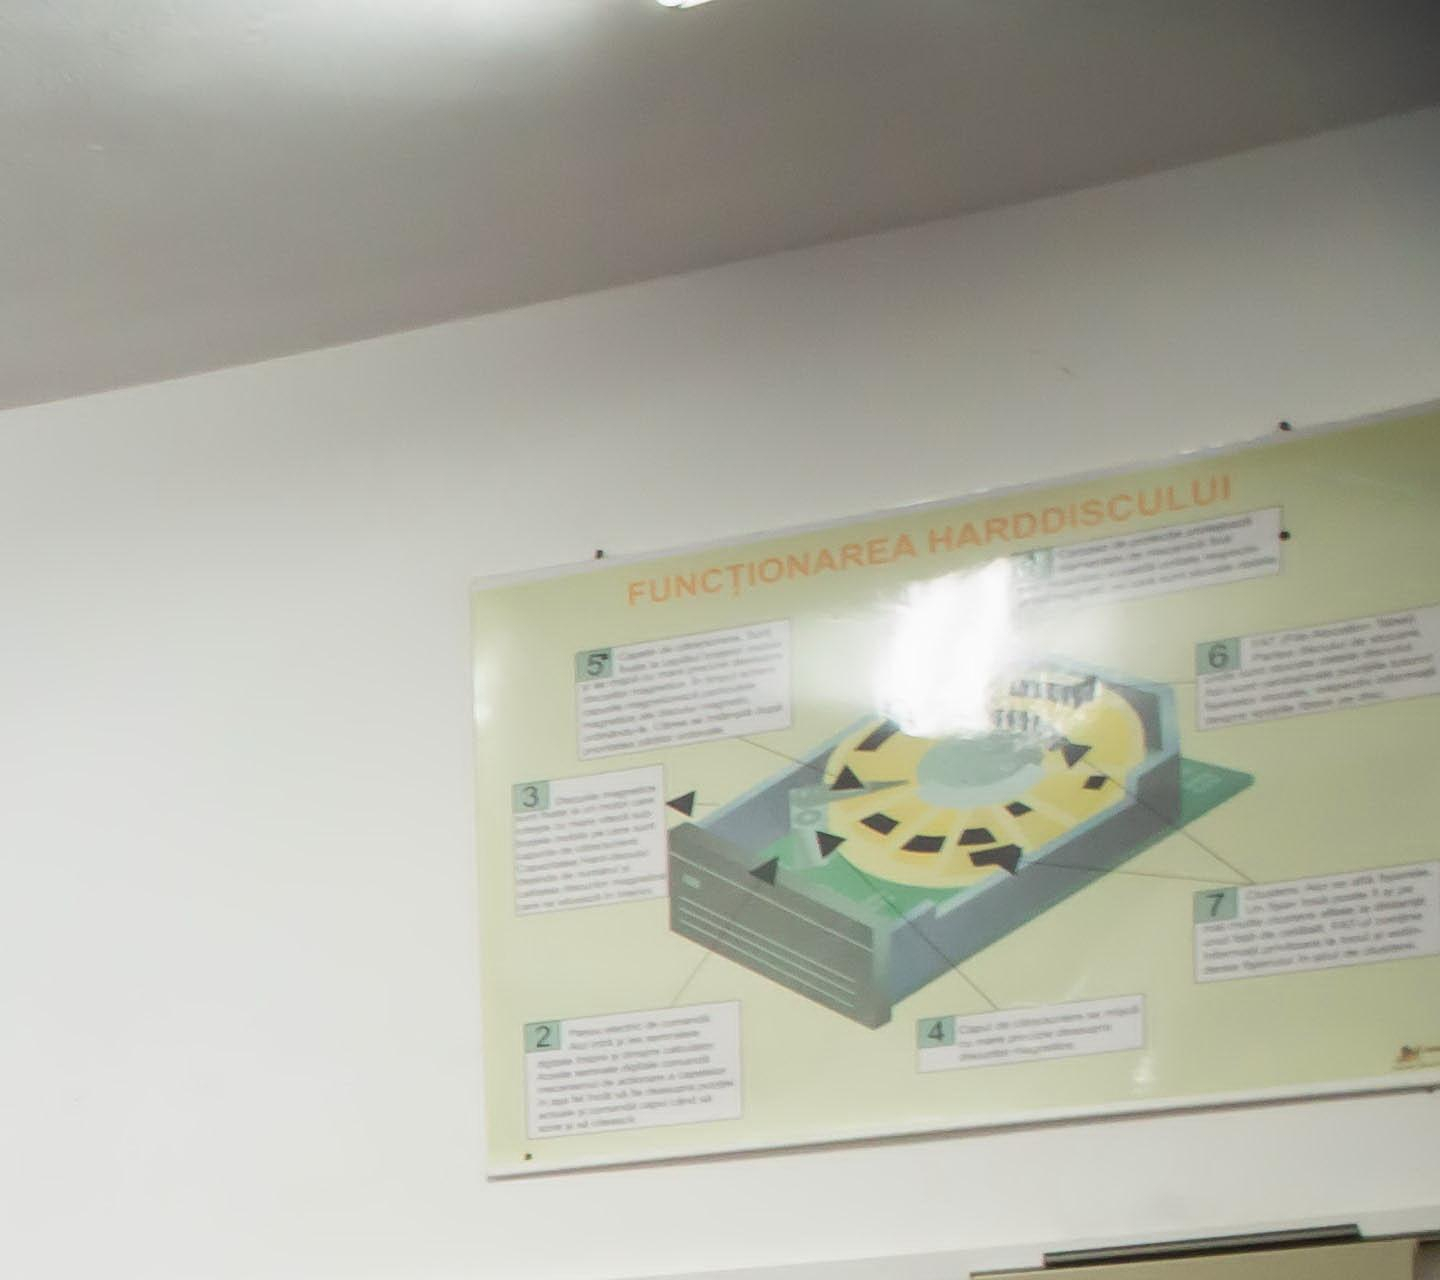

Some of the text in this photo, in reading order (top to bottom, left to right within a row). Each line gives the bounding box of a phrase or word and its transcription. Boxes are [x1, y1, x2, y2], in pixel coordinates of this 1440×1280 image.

[928, 475, 1232, 555] HARDDISCULUI
[586, 653, 609, 677] 5
[1207, 643, 1229, 669] 6
[521, 785, 539, 808] 3
[1205, 892, 1225, 917] 7
[534, 1024, 553, 1049] 2
[927, 1020, 945, 1043] 4
